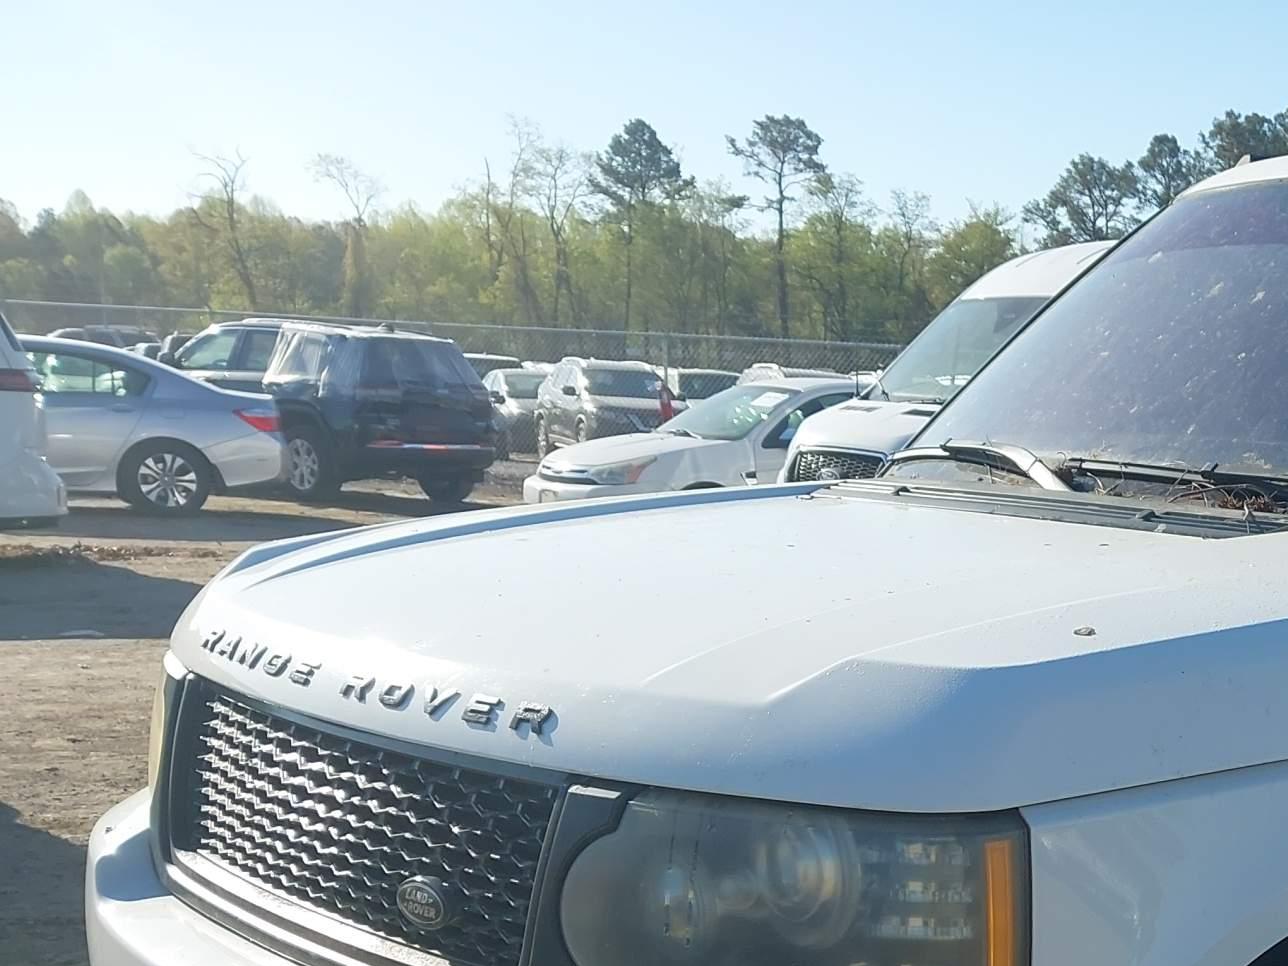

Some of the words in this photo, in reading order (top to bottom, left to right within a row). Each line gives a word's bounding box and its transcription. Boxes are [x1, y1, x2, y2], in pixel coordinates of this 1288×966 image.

[201, 630, 322, 687] RANGE
[339, 674, 554, 737] ROVER
[405, 887, 429, 904] LAND
[407, 901, 436, 919] ROVER
